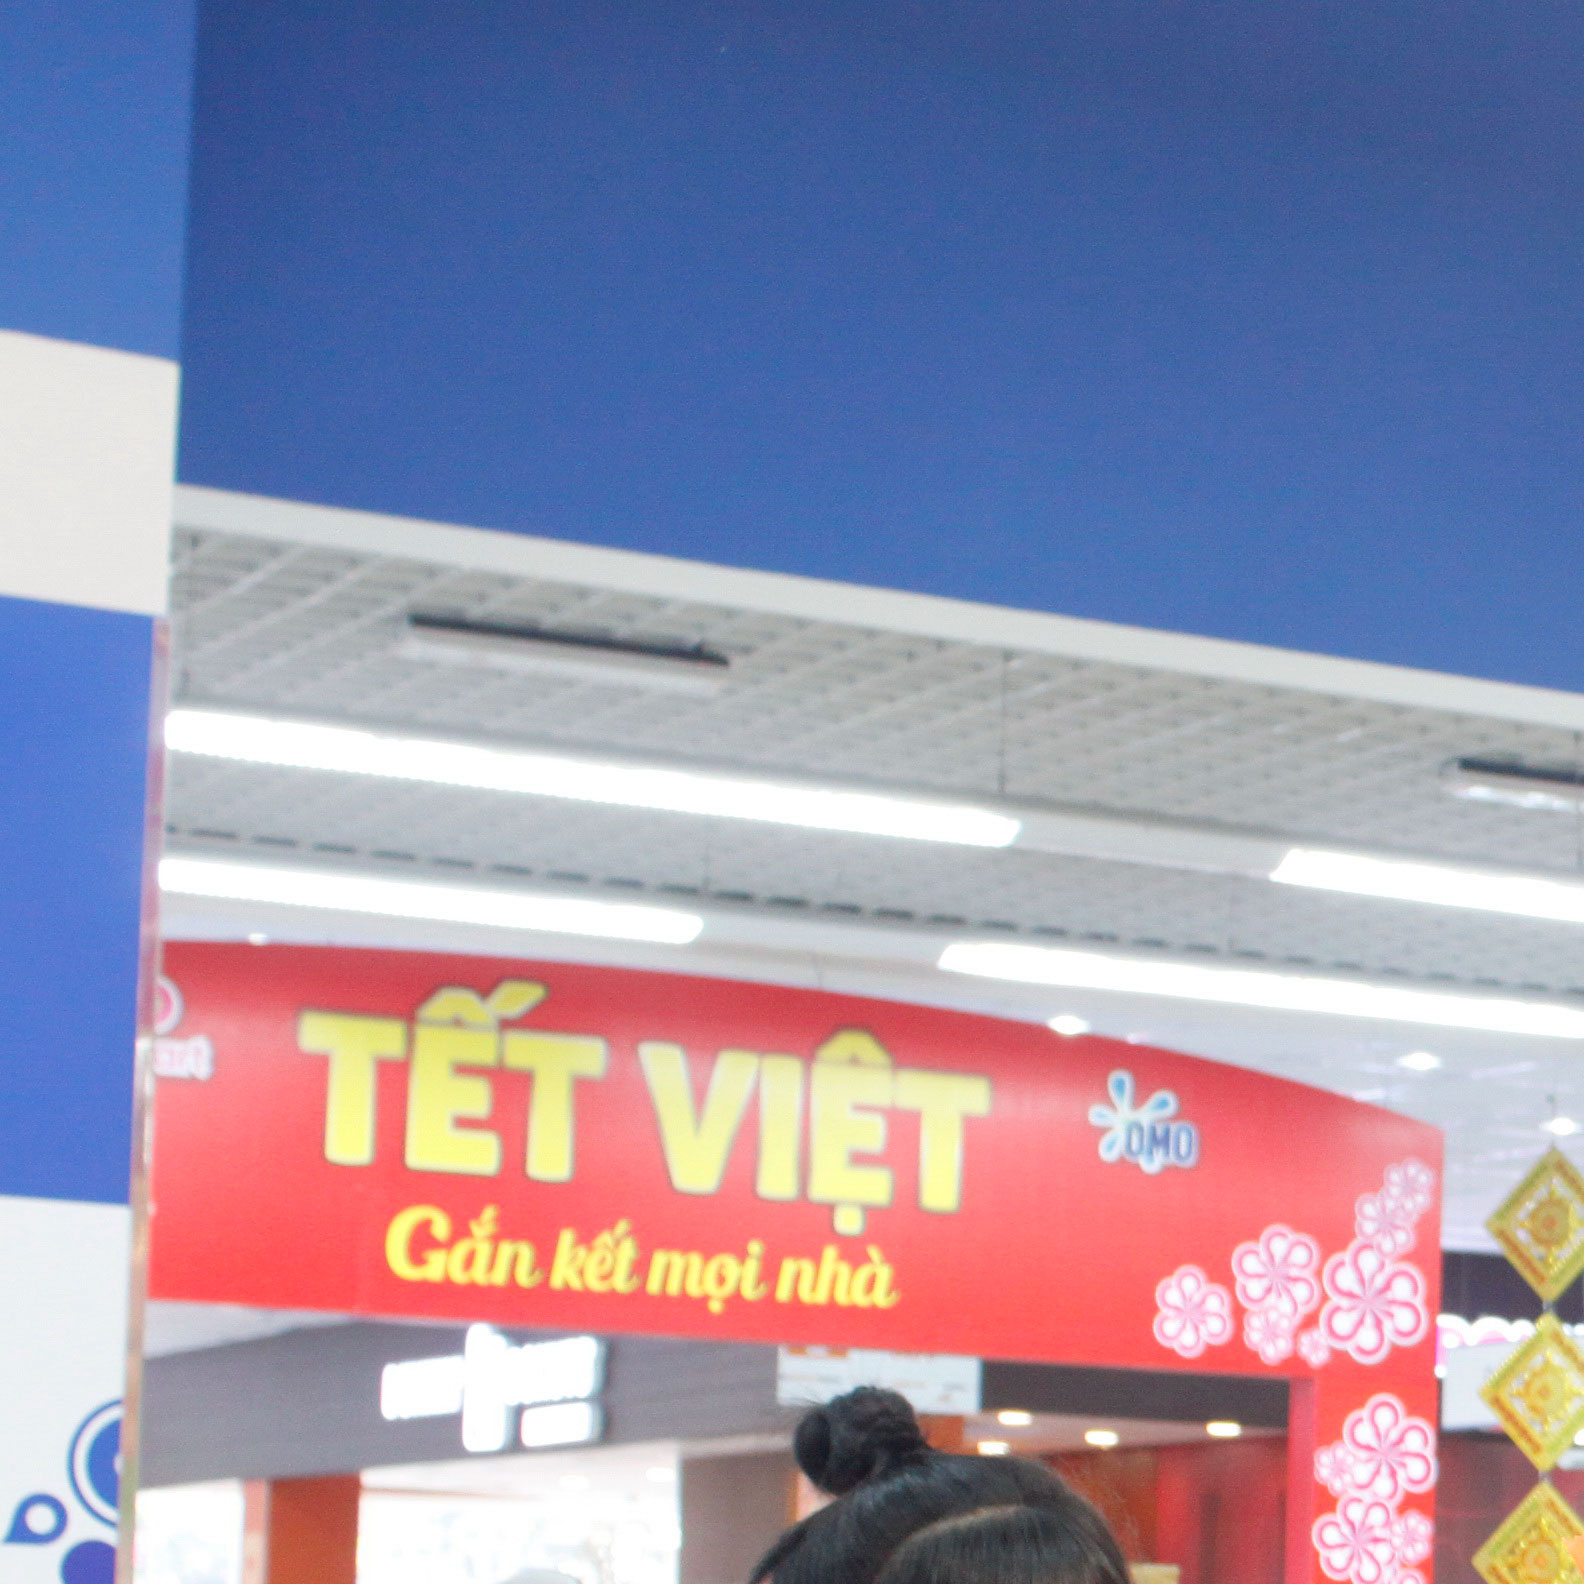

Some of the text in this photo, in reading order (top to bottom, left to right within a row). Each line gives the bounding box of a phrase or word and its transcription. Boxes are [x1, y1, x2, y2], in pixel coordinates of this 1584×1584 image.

[297, 979, 993, 1237] TẾT VIỆT
[1122, 1117, 1199, 1168] OMO
[384, 1203, 902, 1314] Gắn kết mọi nhà
